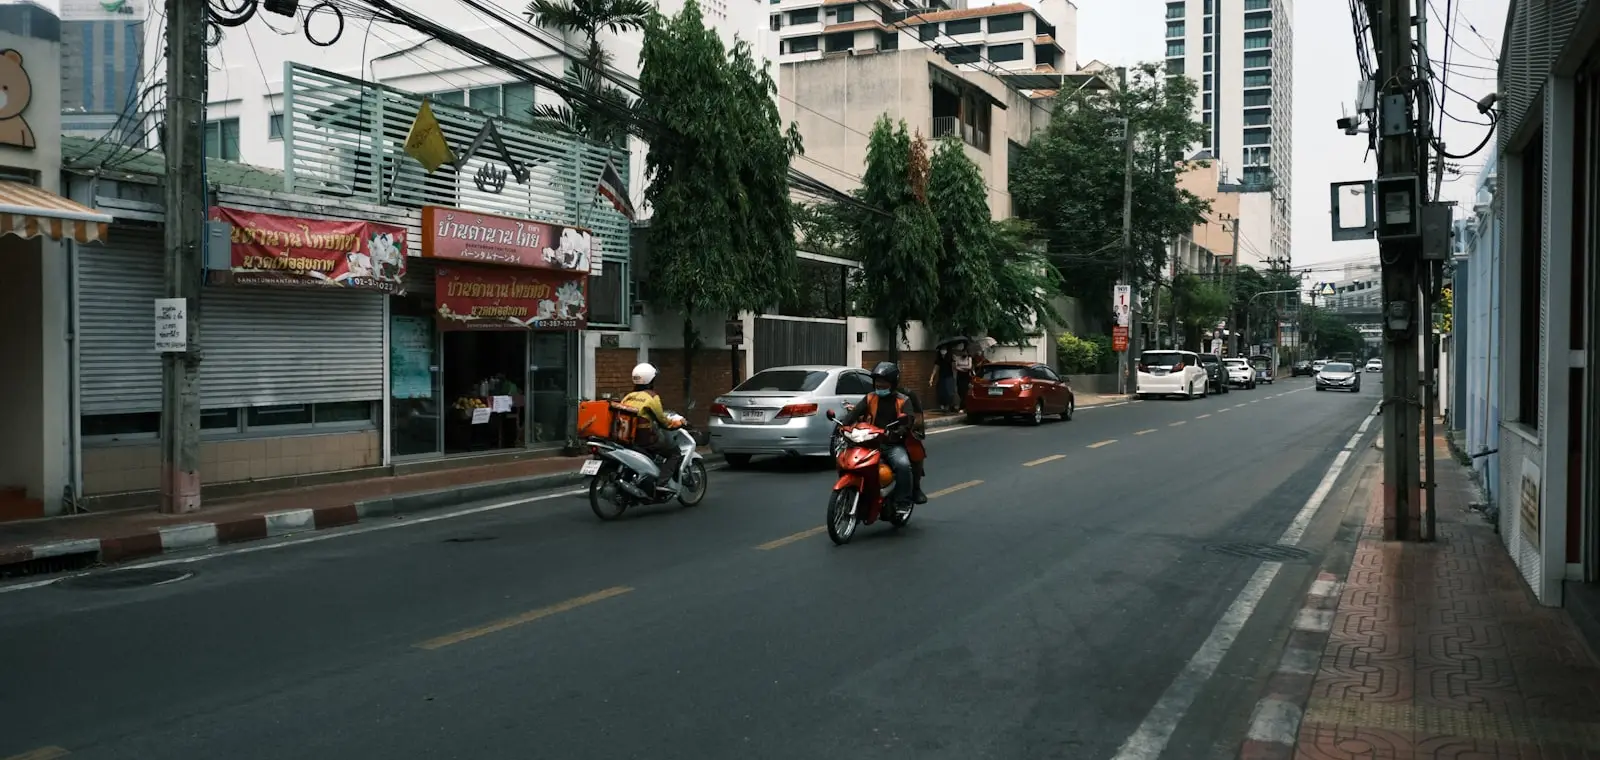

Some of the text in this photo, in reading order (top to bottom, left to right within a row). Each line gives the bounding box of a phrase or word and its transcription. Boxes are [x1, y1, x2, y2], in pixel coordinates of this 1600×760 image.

[438, 214, 541, 247] บ้านตำนานไทย
[243, 249, 335, 275] นวดเพื่อสุขภาพ
[1119, 294, 1125, 305] 1
